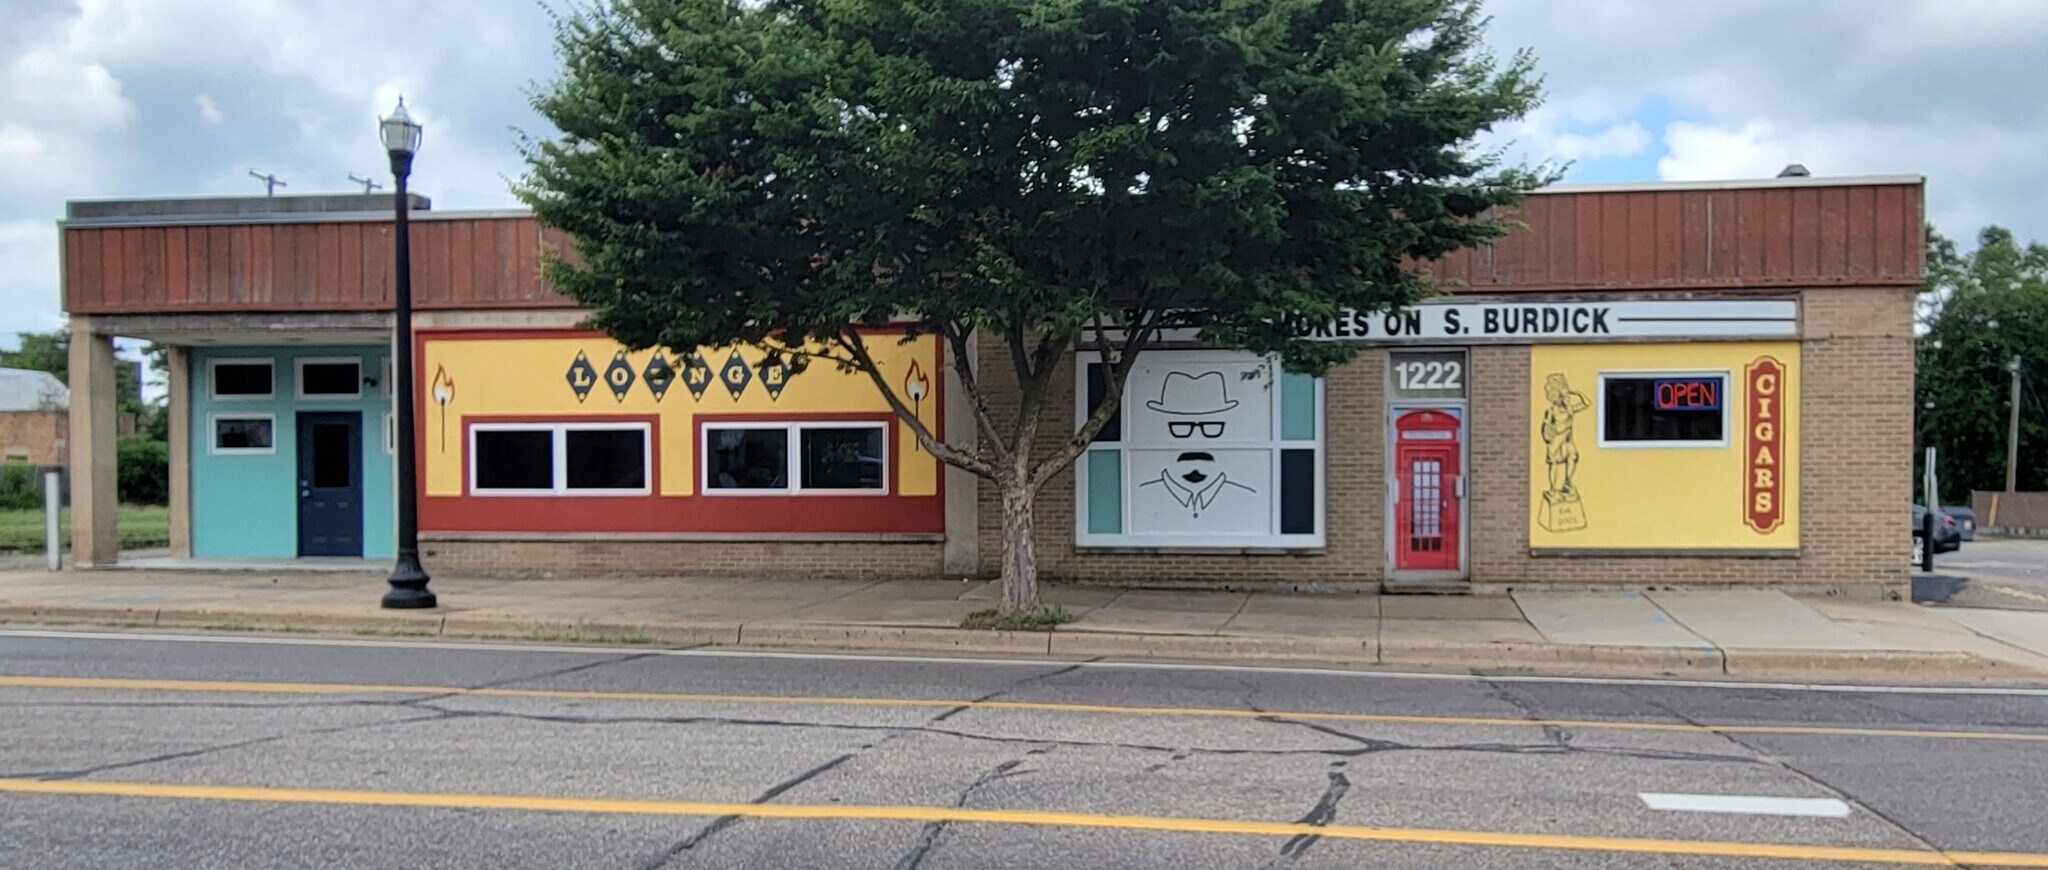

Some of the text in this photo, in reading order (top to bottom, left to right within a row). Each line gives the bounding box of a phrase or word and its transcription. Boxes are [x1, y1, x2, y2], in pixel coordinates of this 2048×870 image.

[1384, 310, 1421, 337] ON
[1444, 308, 1469, 335] S.
[1484, 308, 1610, 334] BURDICK
[1395, 361, 1461, 389] 1222
[1658, 382, 1715, 408] OPEN
[1754, 374, 1776, 513] CIGARS
